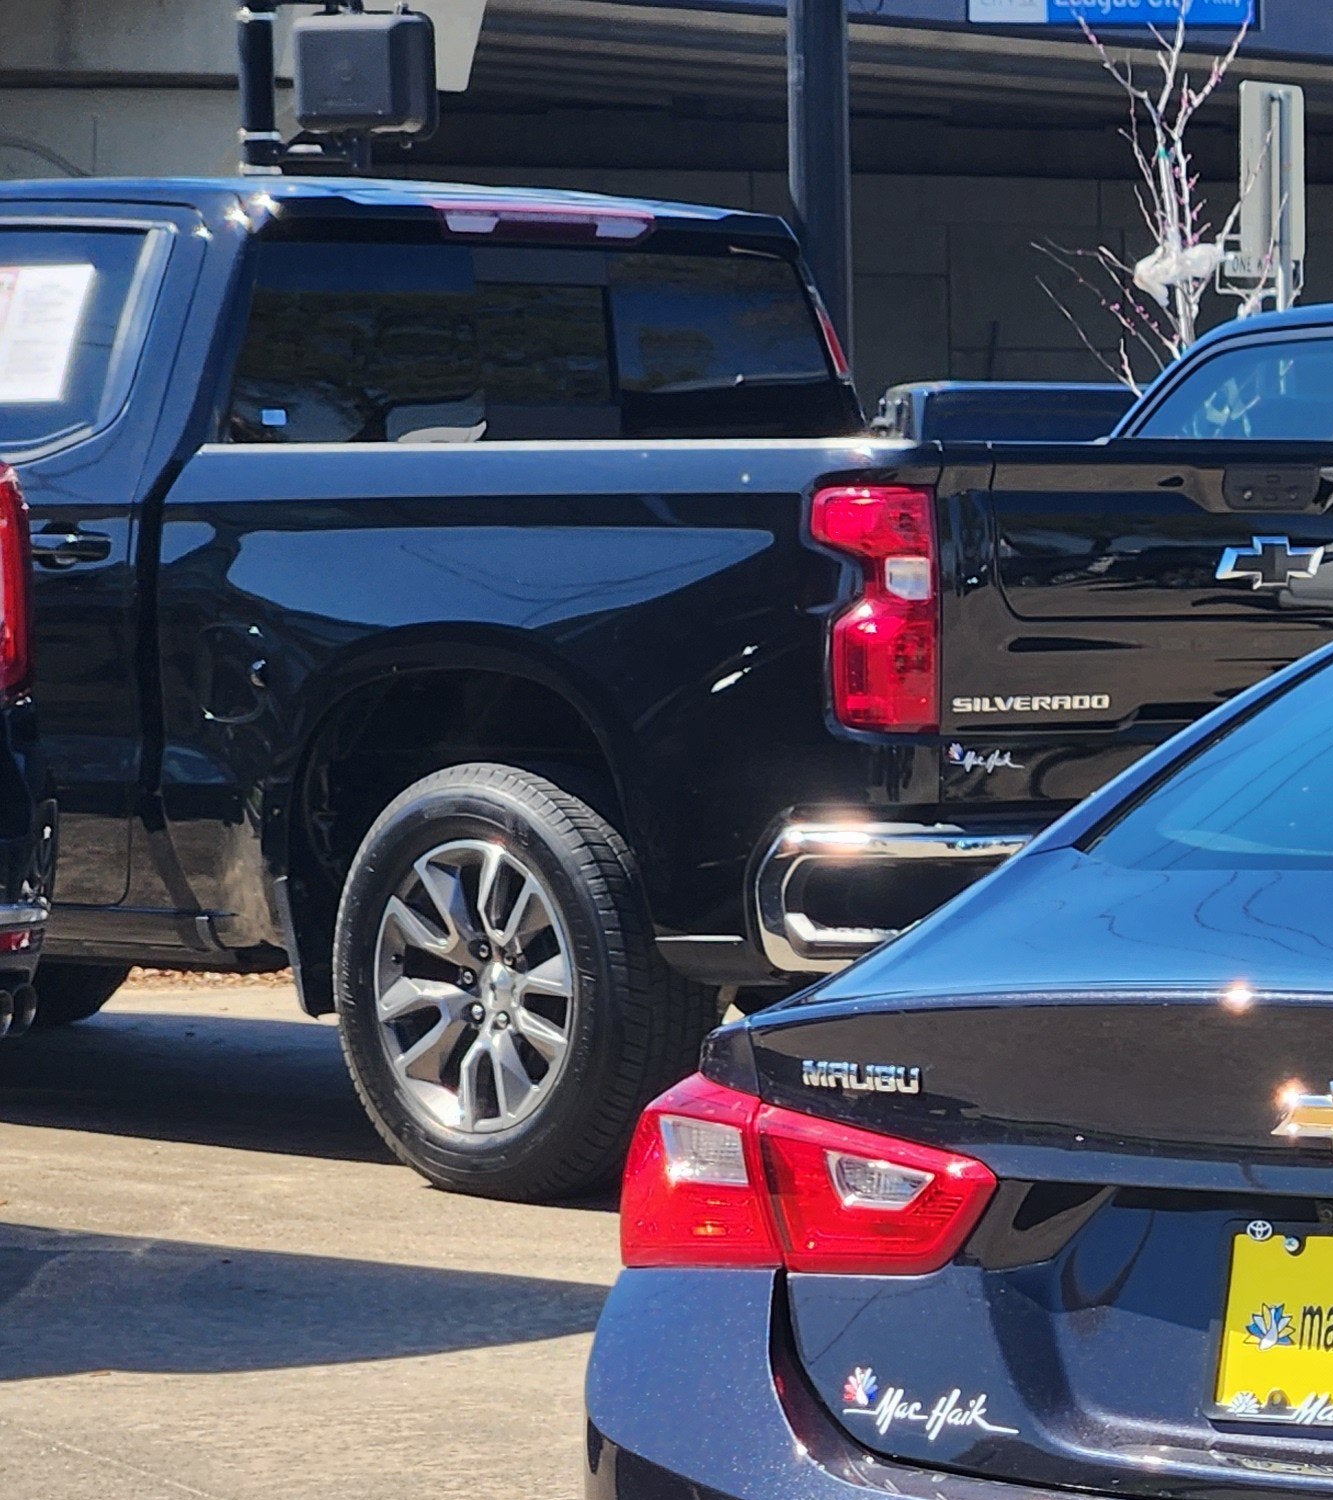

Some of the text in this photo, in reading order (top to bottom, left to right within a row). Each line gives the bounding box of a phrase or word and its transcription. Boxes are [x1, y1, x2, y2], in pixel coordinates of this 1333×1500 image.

[952, 694, 1110, 713] SILVERADO
[802, 1060, 920, 1094] MALIBU
[850, 1387, 1017, 1441] Mac Haik
